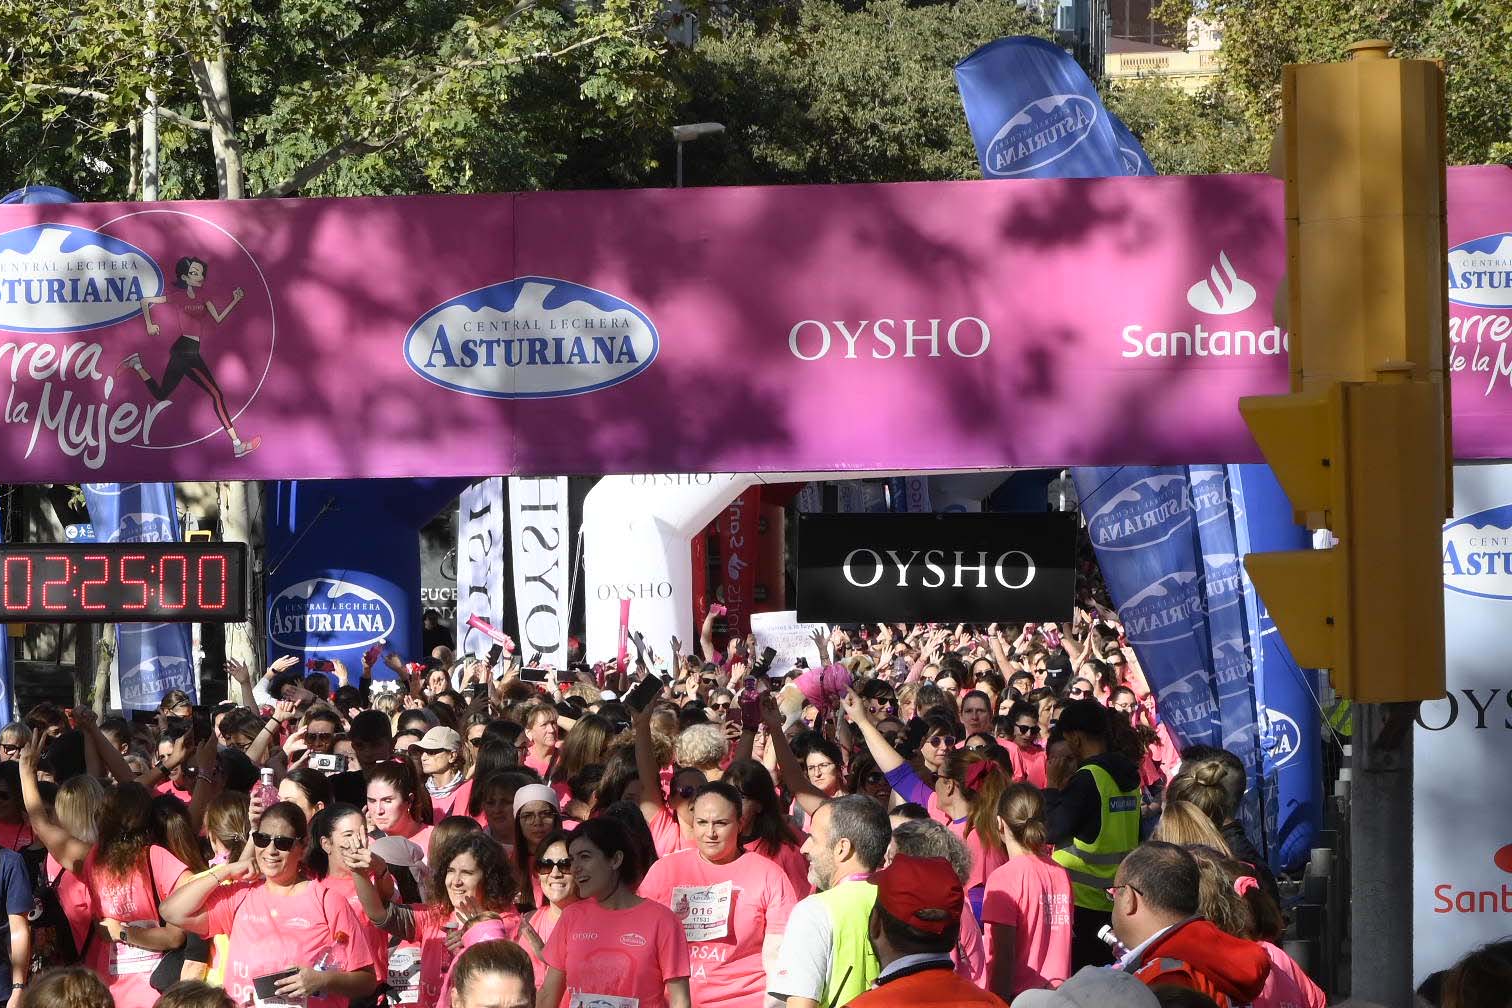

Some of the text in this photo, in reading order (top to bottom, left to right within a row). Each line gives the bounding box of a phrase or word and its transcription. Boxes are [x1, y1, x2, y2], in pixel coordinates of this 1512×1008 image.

[66, 259, 138, 272] LECHERA
[463, 317, 631, 333] CENTRAL LECHERA
[788, 316, 991, 361] OYSHO
[423, 323, 639, 368] ASTURIANA
[1121, 324, 1288, 358] Santand
[1472, 344, 1490, 372] la
[4, 384, 29, 424] la
[24, 375, 173, 470] Mujer
[4, 556, 226, 609] 02:25:00
[843, 548, 1036, 589] OYSHO
[597, 582, 673, 600] OYSHO
[272, 605, 385, 635] ASTURIANA
[327, 602, 380, 611] LECHERA
[691, 907, 713, 915] 016
[233, 960, 248, 977] TU
